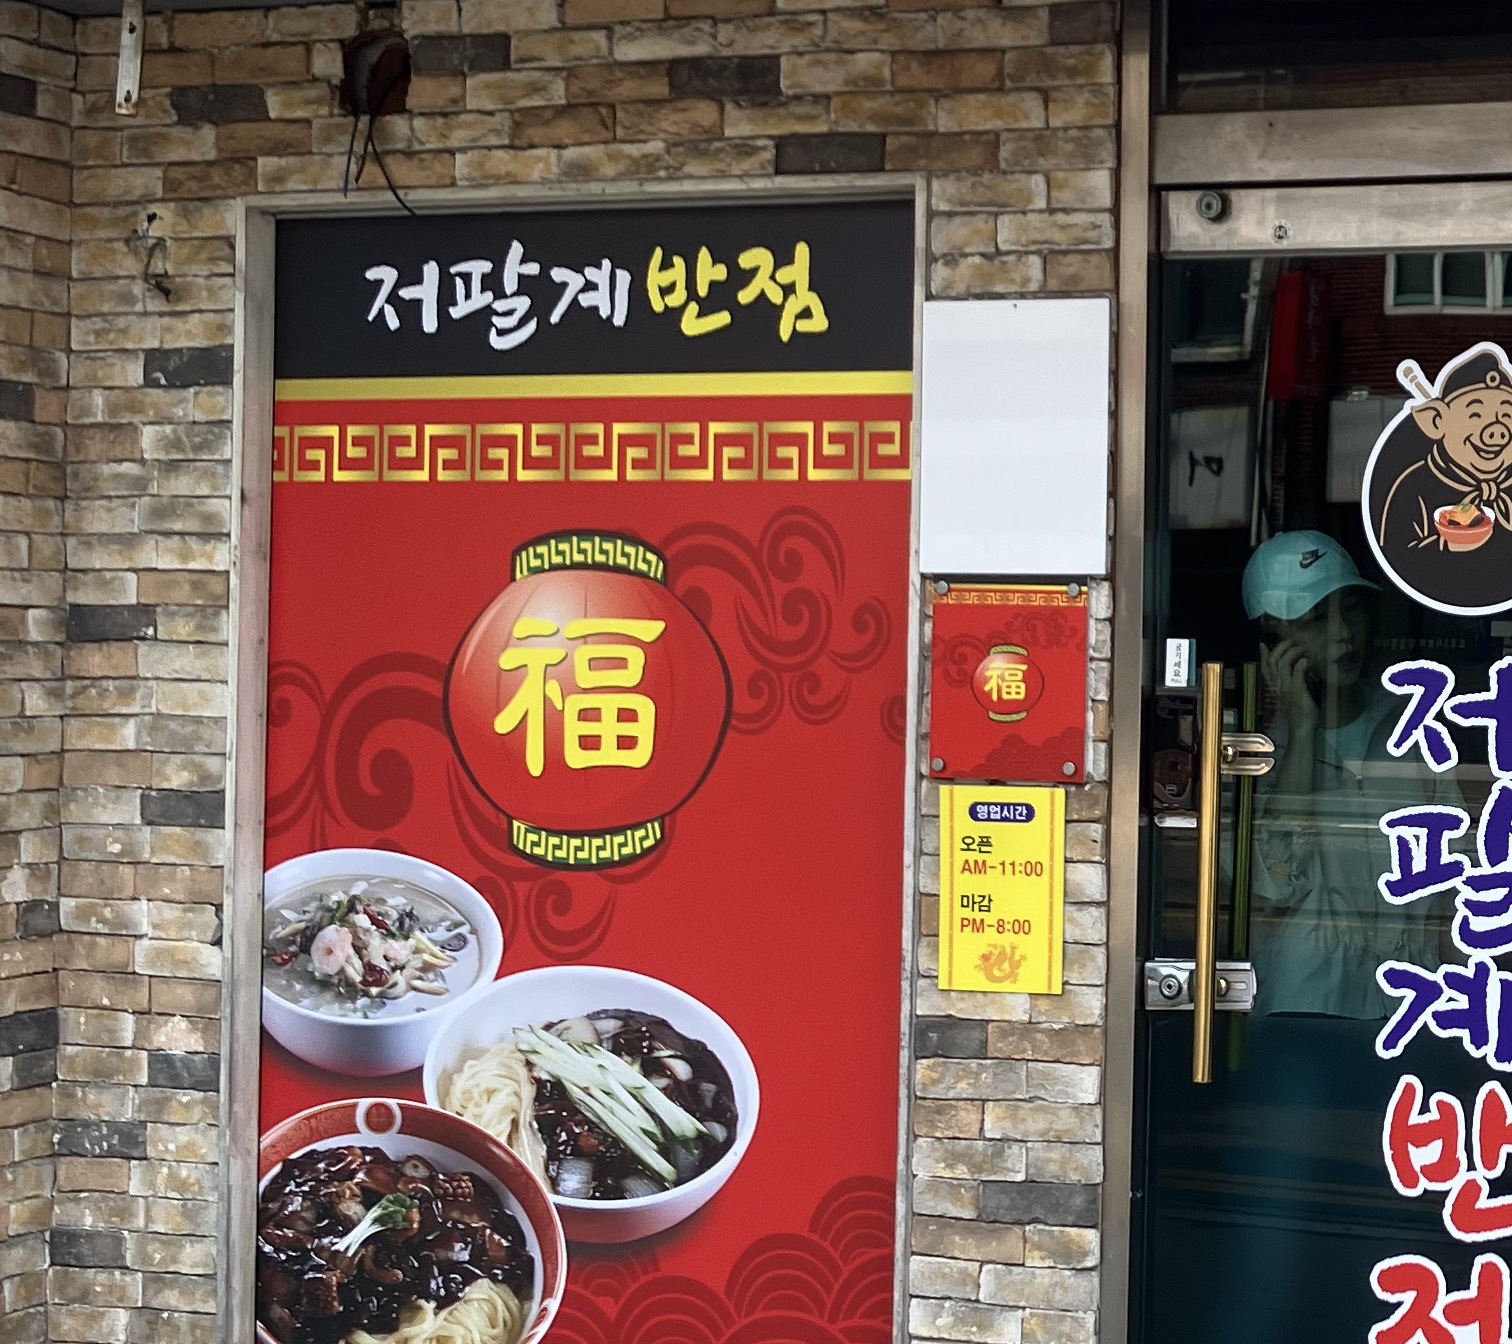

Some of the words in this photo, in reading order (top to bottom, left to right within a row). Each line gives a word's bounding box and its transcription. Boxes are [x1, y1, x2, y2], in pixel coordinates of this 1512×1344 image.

[365, 240, 632, 351] 저팔계
[646, 242, 830, 343] 반점
[984, 663, 1028, 701] 福
[494, 616, 666, 777] 福
[976, 804, 1028, 820] 영업시간
[960, 835, 993, 854] 오픈
[960, 859, 1044, 877] AM-11:00
[960, 894, 993, 913] 마감
[960, 917, 1032, 935] PM-8:00
